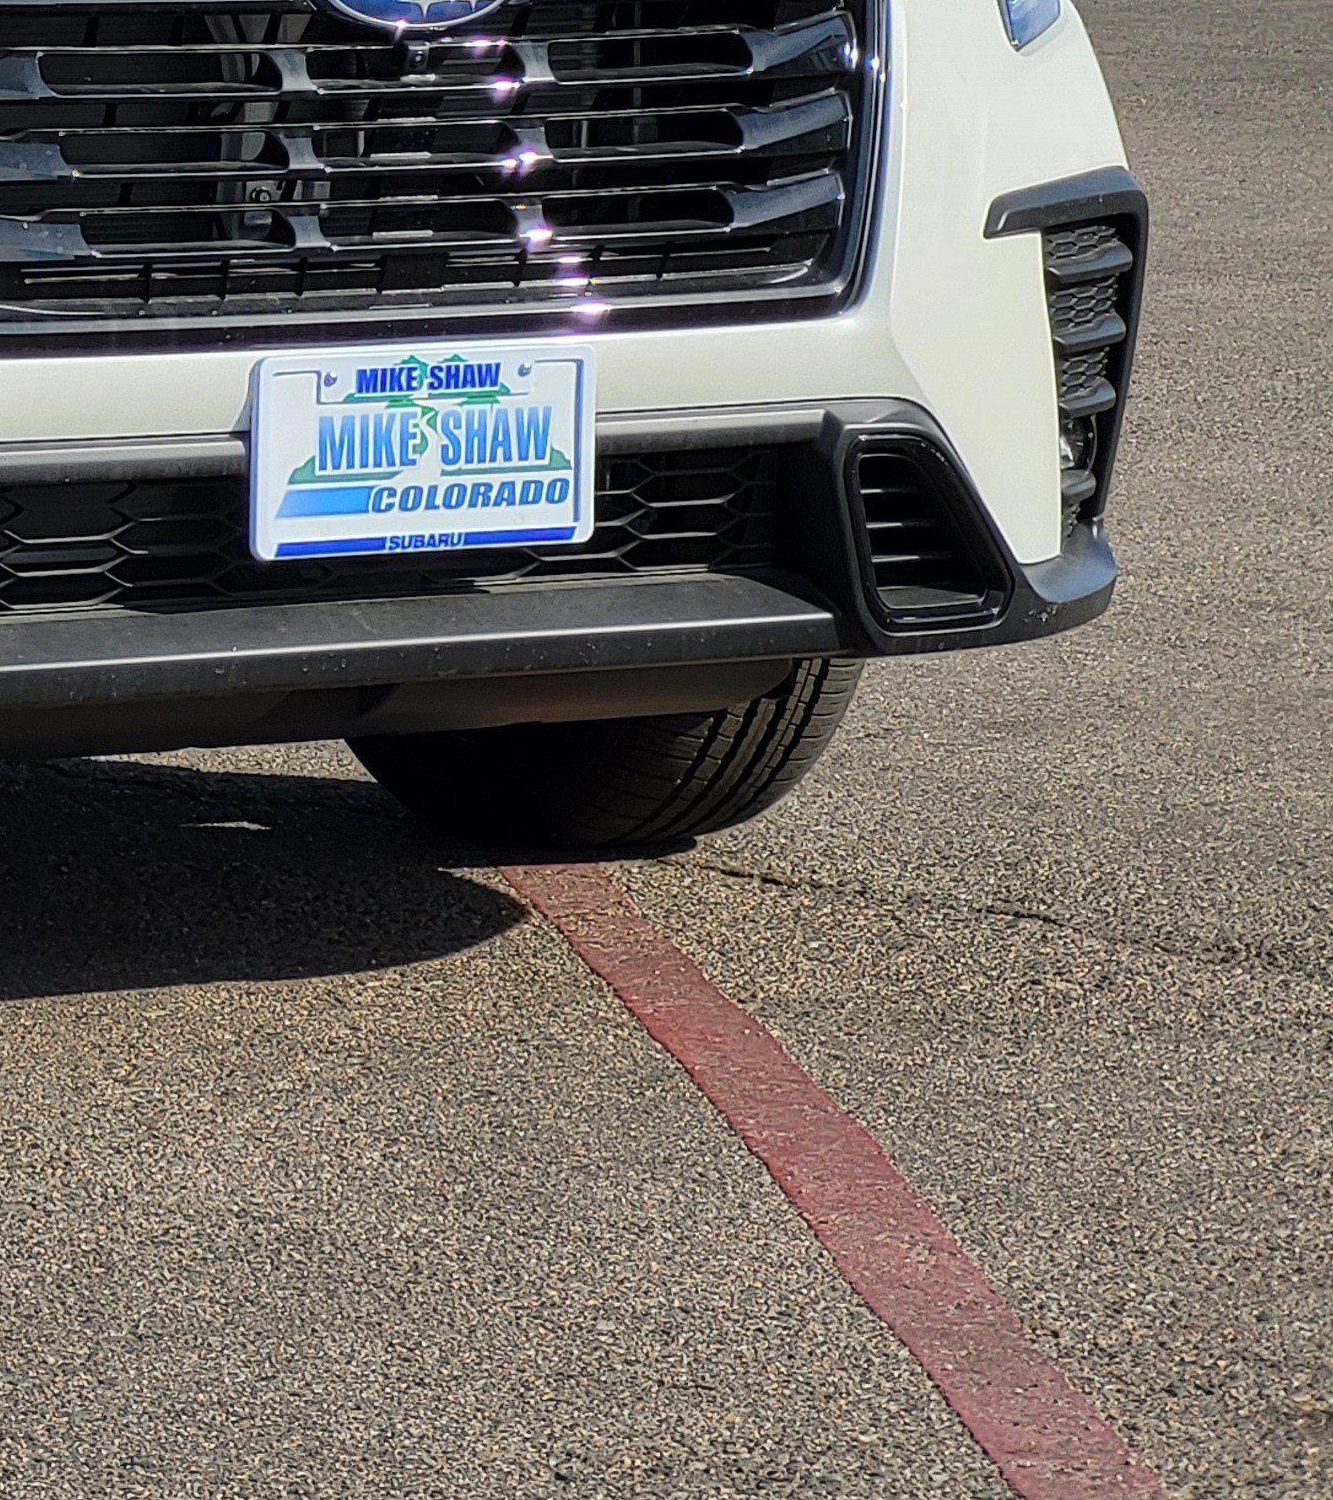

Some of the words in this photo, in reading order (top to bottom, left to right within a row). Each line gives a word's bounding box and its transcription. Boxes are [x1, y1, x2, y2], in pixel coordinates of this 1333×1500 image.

[356, 367, 417, 393] MIKE
[428, 362, 501, 390] SHAW
[318, 411, 418, 471] MIKE
[440, 406, 552, 466] SHAW
[371, 477, 570, 514] COLORADO
[387, 533, 465, 550] SUBARU
